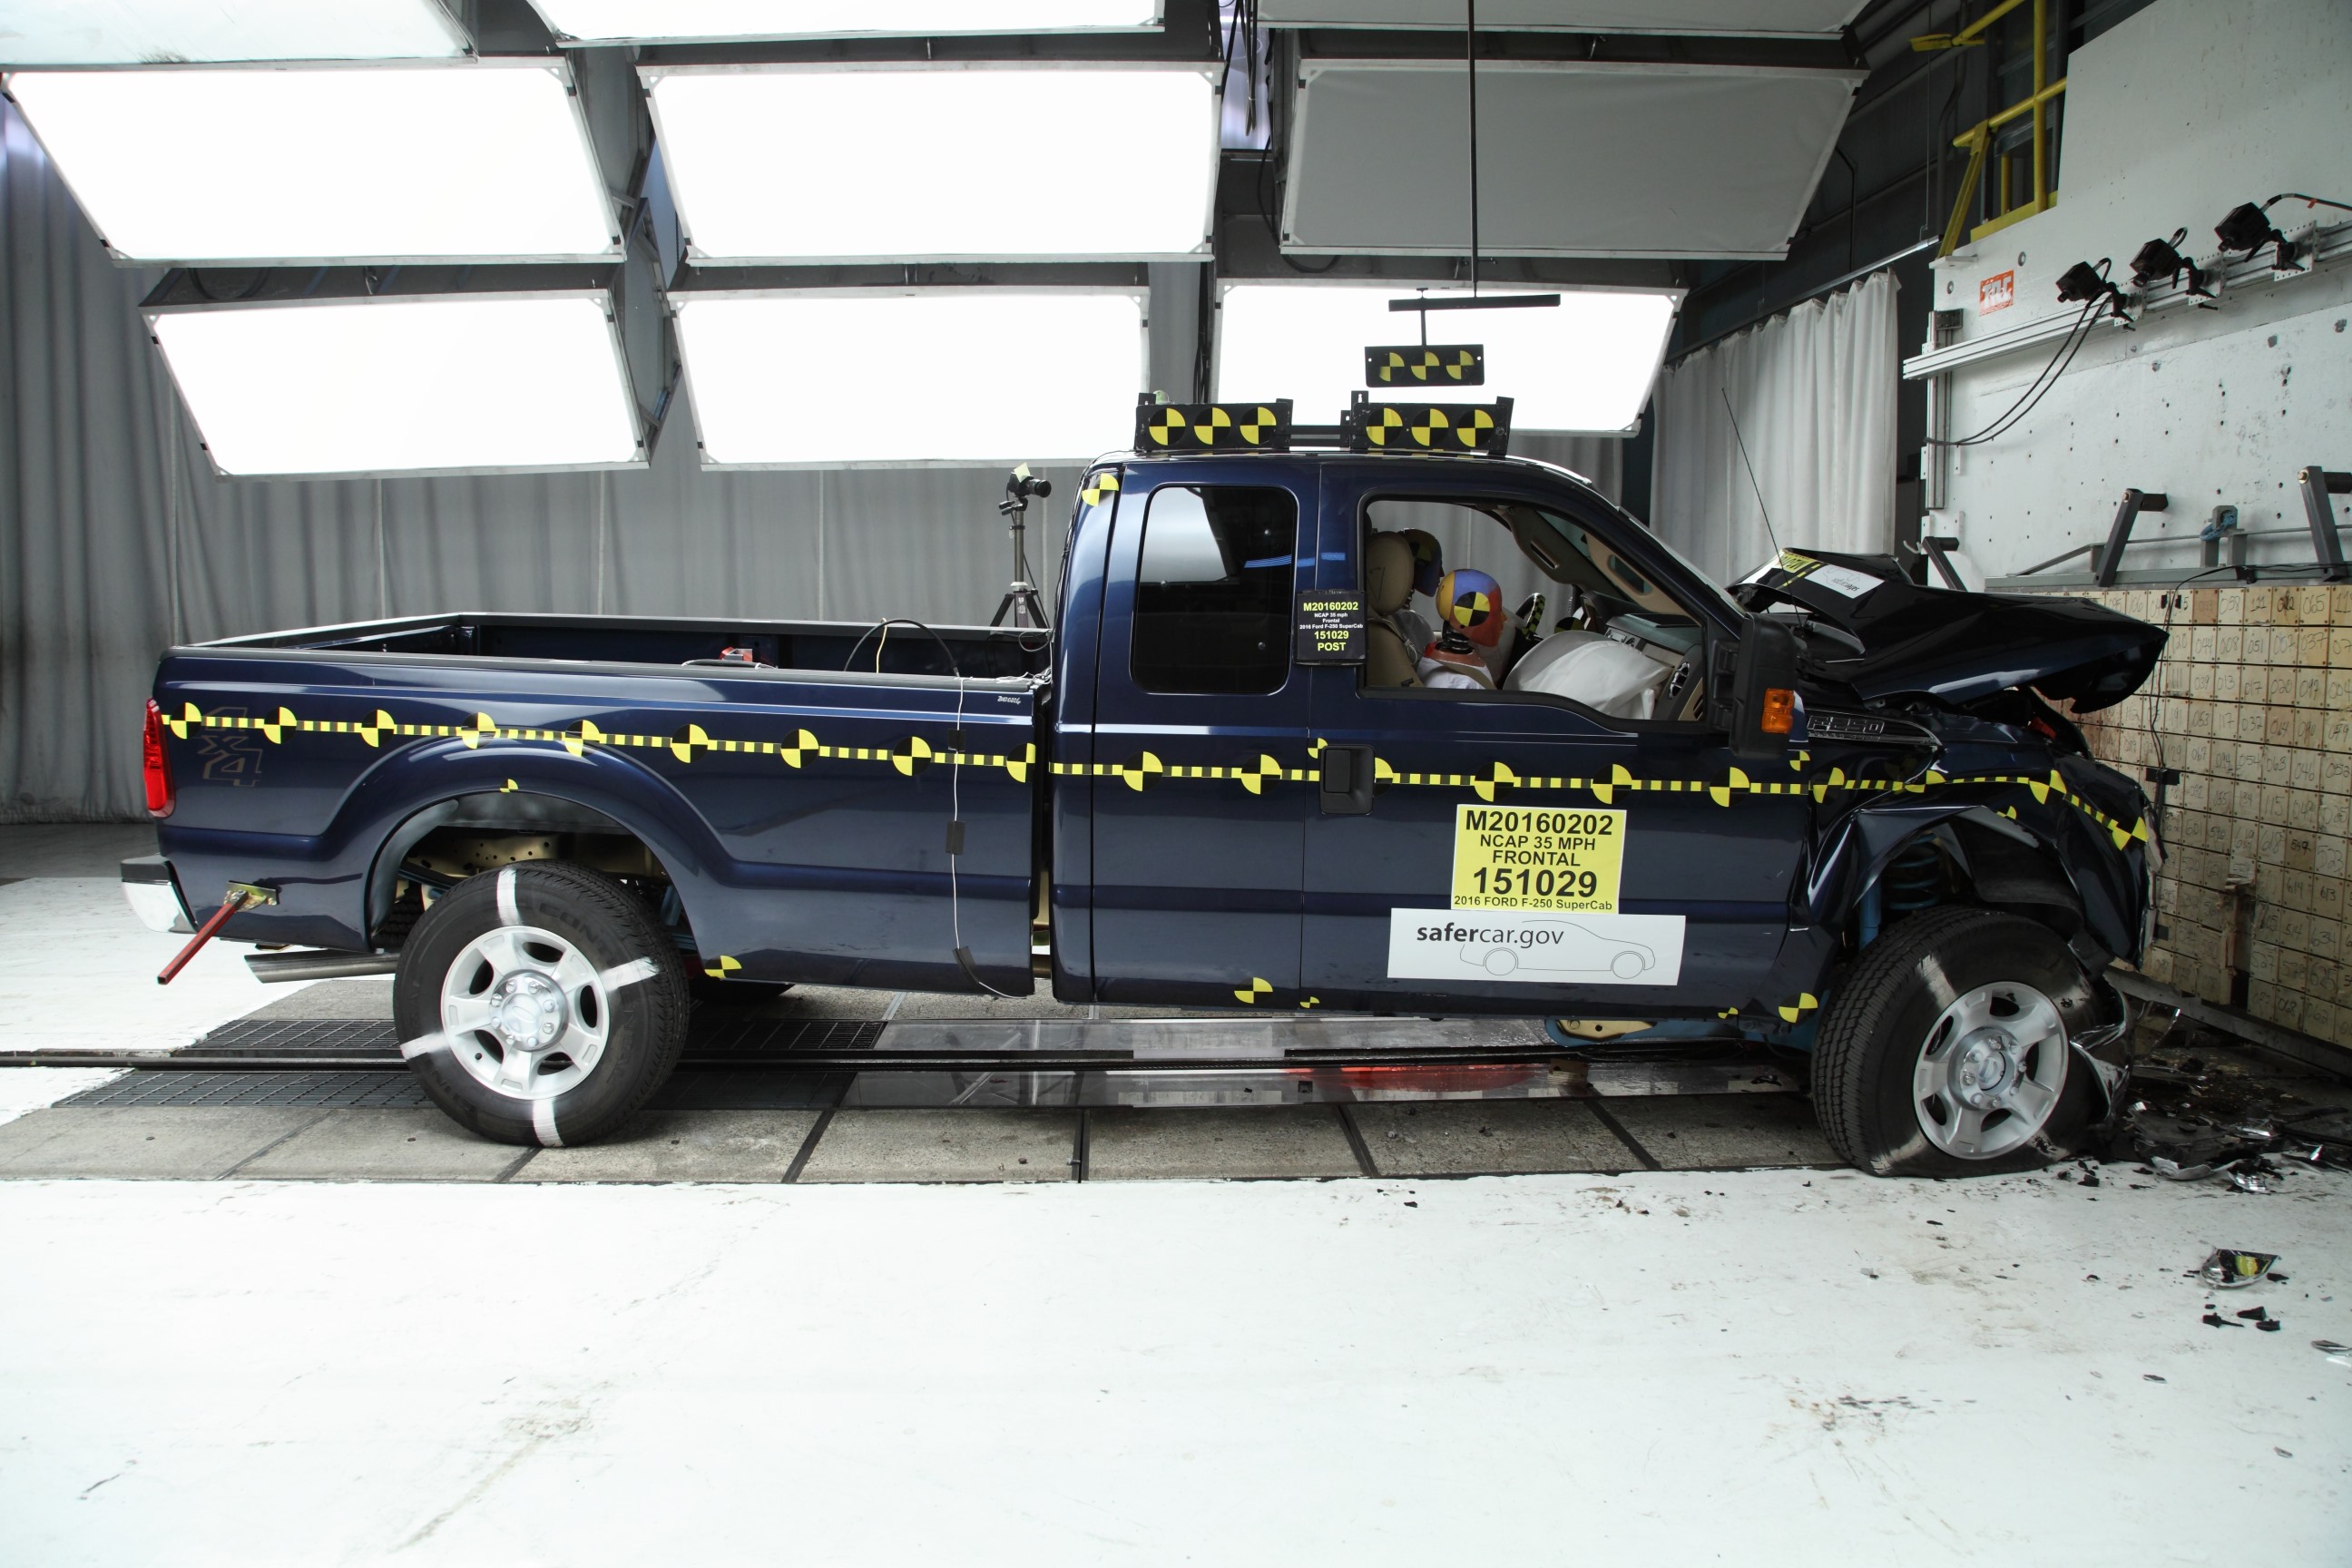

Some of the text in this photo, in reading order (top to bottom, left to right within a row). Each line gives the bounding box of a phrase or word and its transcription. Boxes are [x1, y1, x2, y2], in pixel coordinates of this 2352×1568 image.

[1303, 602, 1358, 612] M20160202
[2220, 595, 2240, 615] 058
[2303, 594, 2326, 614] 065
[1314, 631, 1349, 640] 151029
[1318, 642, 1347, 652] POST
[2220, 636, 2239, 654] 008
[2248, 639, 2264, 654] 051
[2195, 674, 2210, 691] 039
[2217, 675, 2236, 691] 013
[2245, 679, 2263, 696] 017
[2264, 794, 2285, 816] 115
[1465, 809, 1613, 836] M20160202
[1480, 835, 1596, 851] NCAP 35 MPH
[1492, 849, 1582, 867] FRONTAL
[1473, 867, 1598, 898] 151029
[1454, 895, 1612, 911] 2016 FORD F-250 SuperCab
[1416, 921, 1565, 949] safercar.gov
